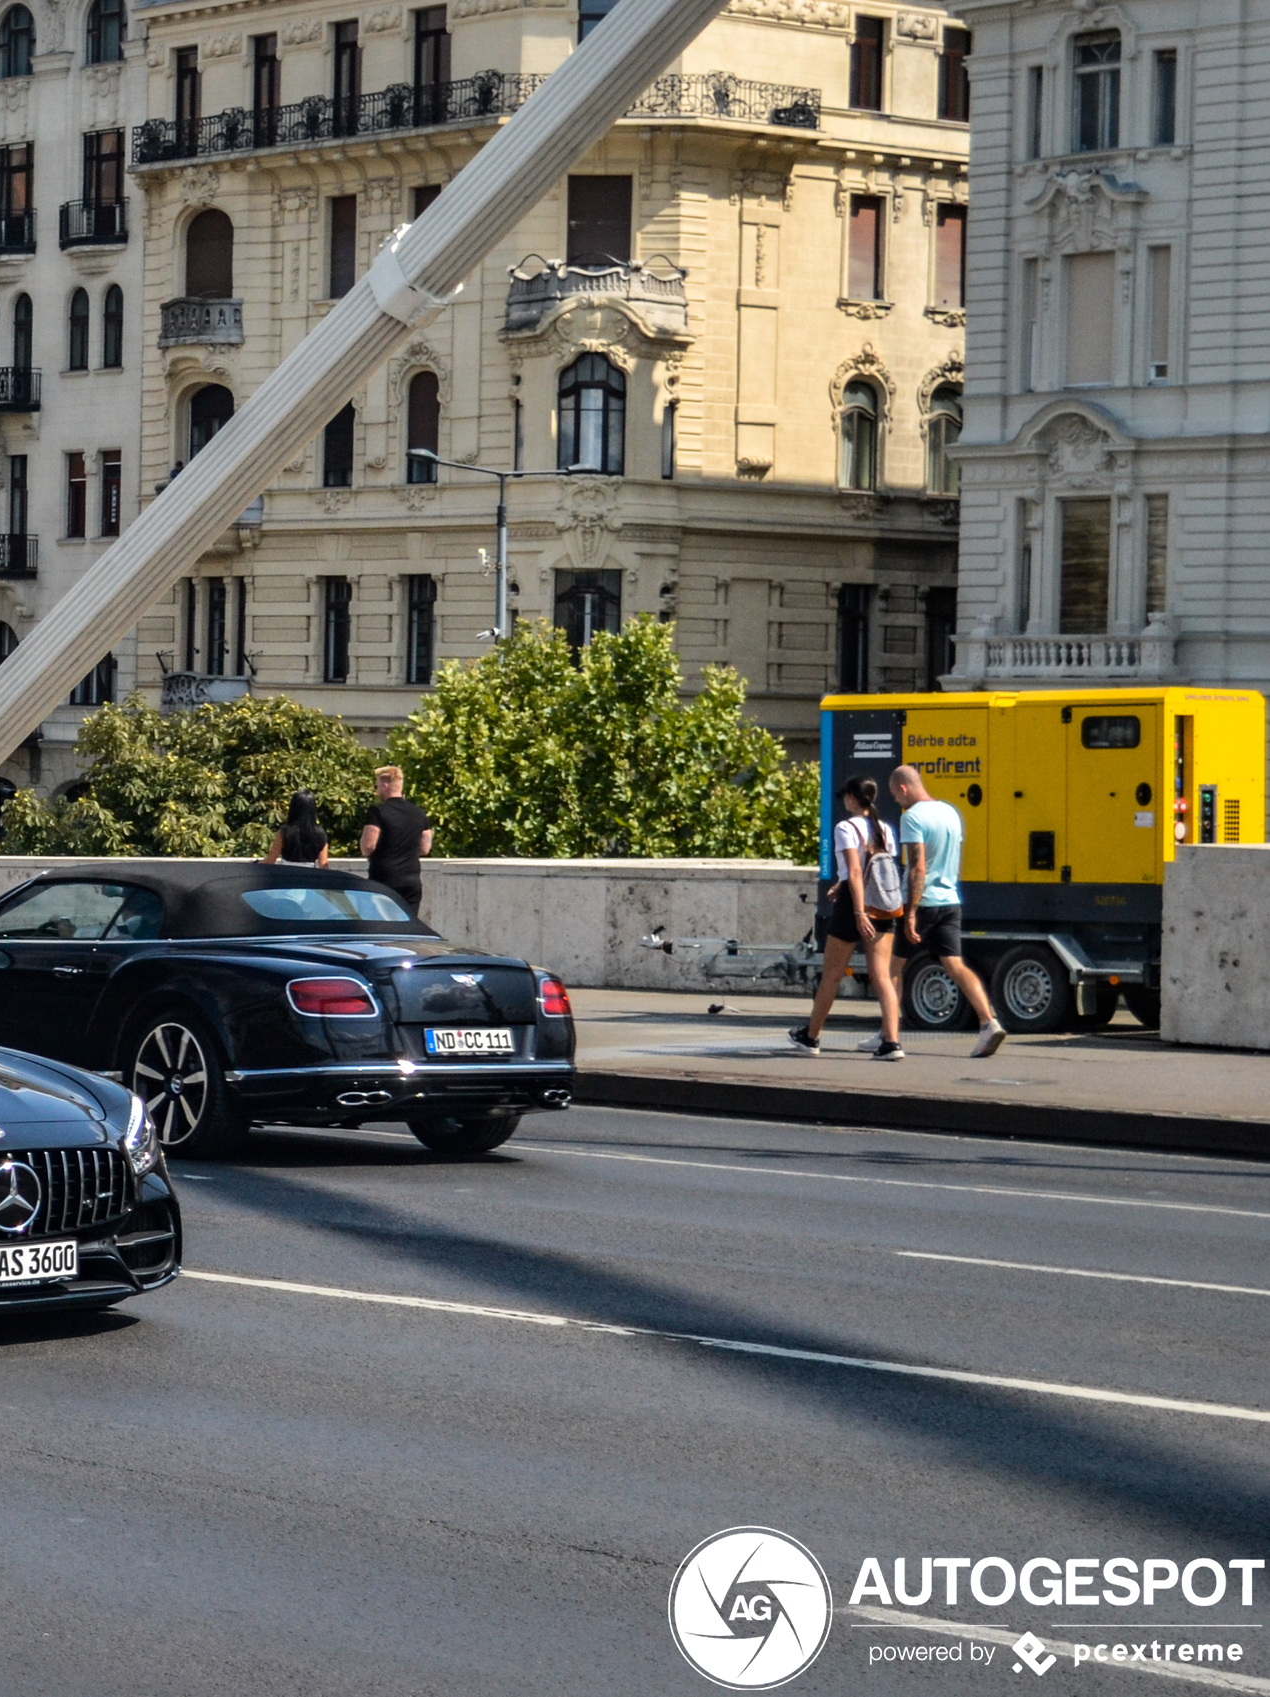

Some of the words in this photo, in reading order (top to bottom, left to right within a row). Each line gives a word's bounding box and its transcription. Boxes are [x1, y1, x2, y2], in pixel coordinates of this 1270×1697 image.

[907, 734, 944, 747] Bérbe
[947, 734, 977, 747] adta
[435, 1032, 456, 1049] ND
[464, 1032, 483, 1049] CC
[485, 1032, 511, 1049] 111
[29, 1244, 75, 1274] 3600
